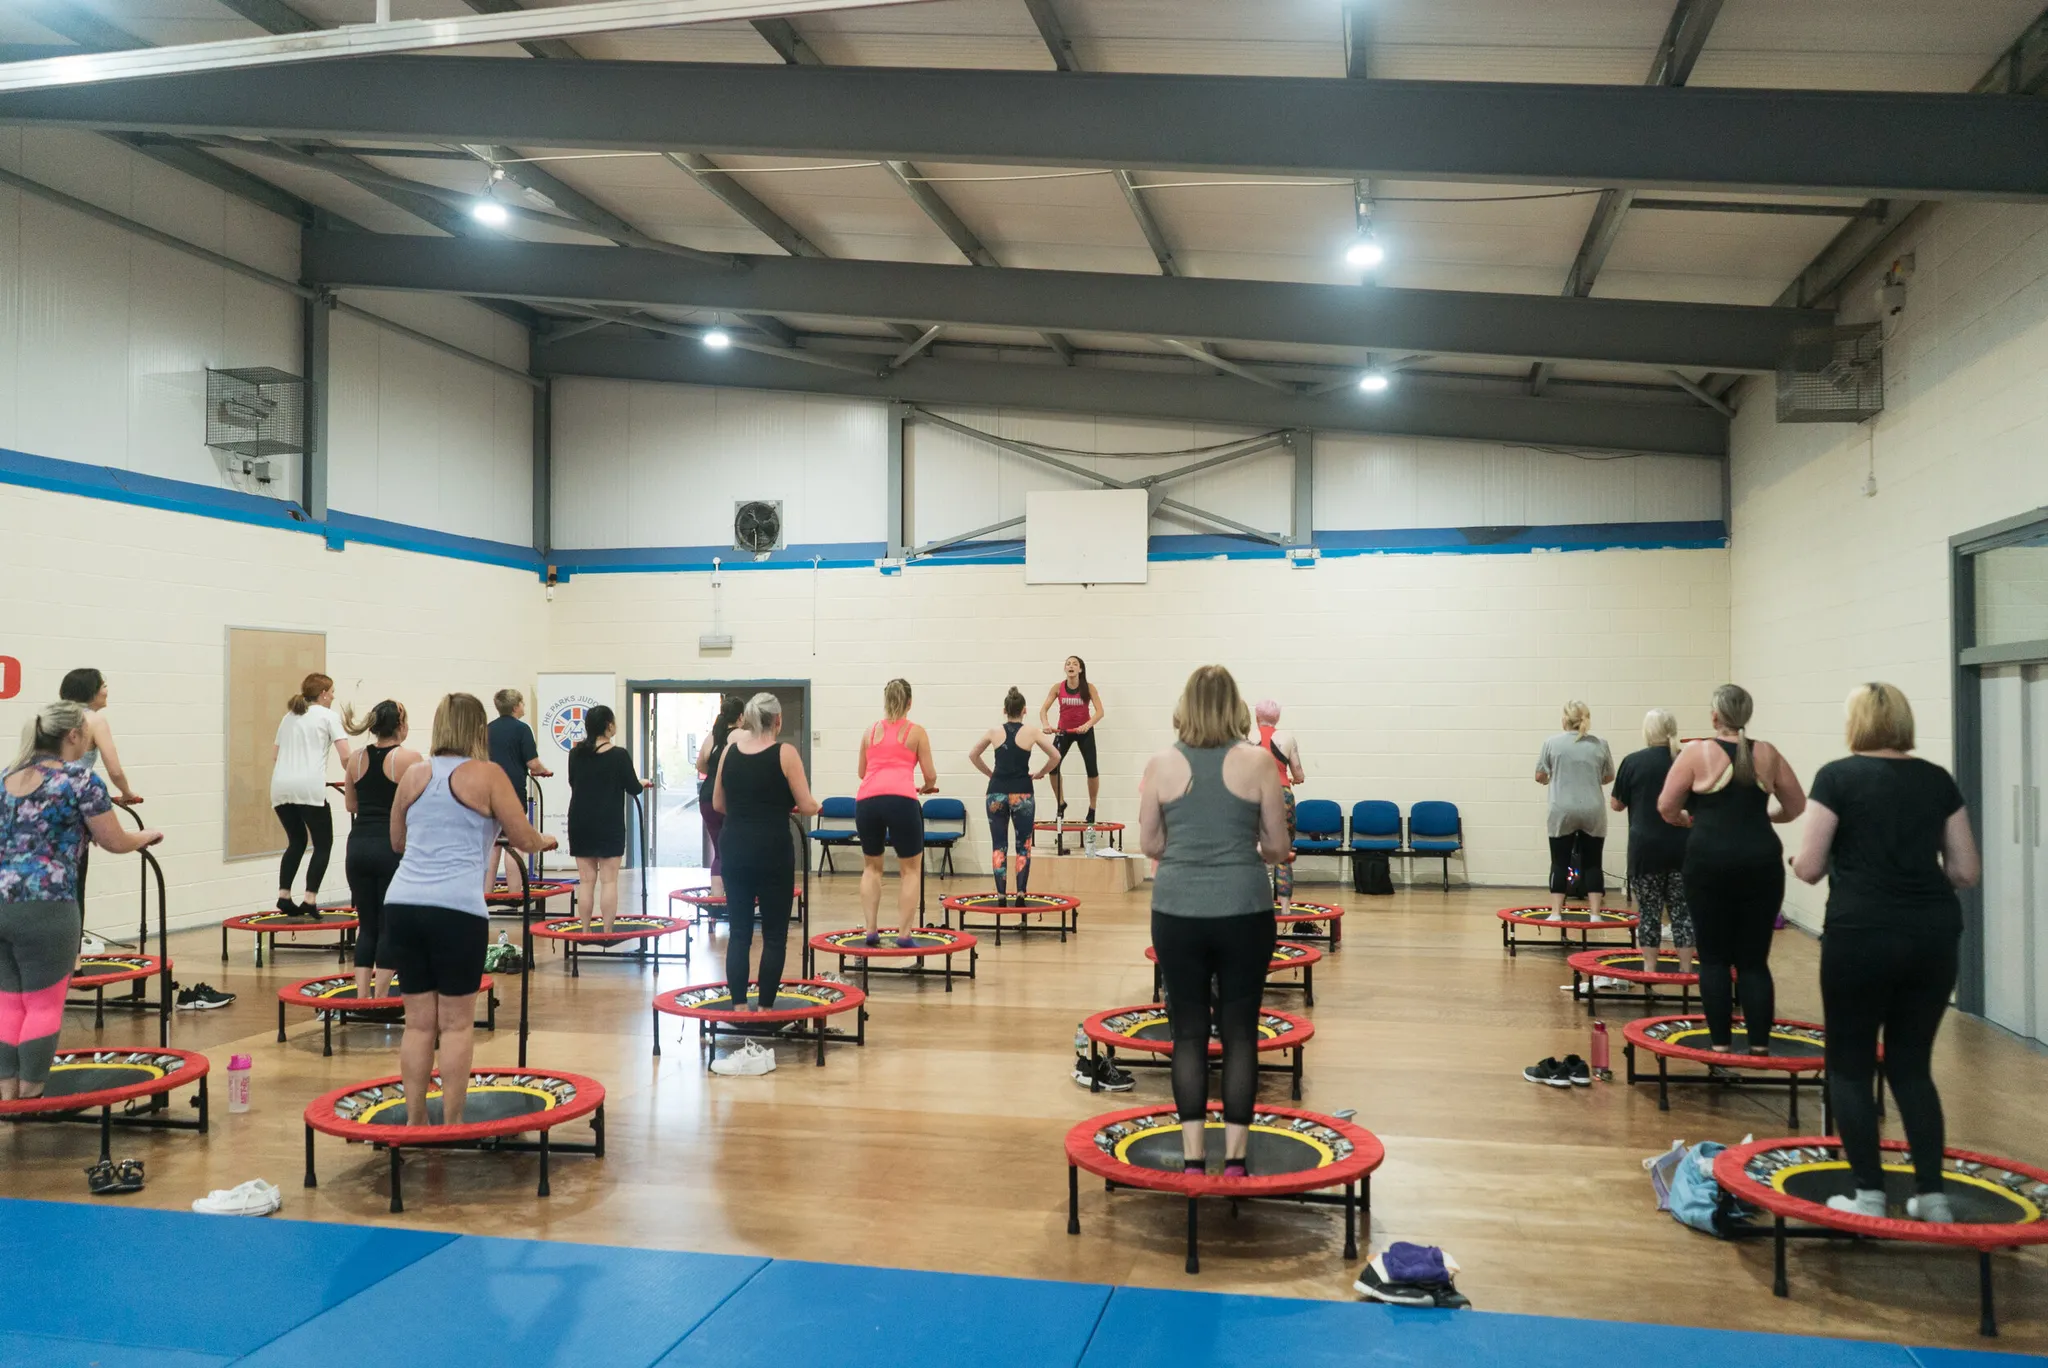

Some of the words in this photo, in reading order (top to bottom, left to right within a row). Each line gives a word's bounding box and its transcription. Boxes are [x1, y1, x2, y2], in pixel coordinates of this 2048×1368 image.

[542, 711, 553, 727] THE
[550, 695, 576, 712] PARKS
[577, 695, 599, 708] JUDO
